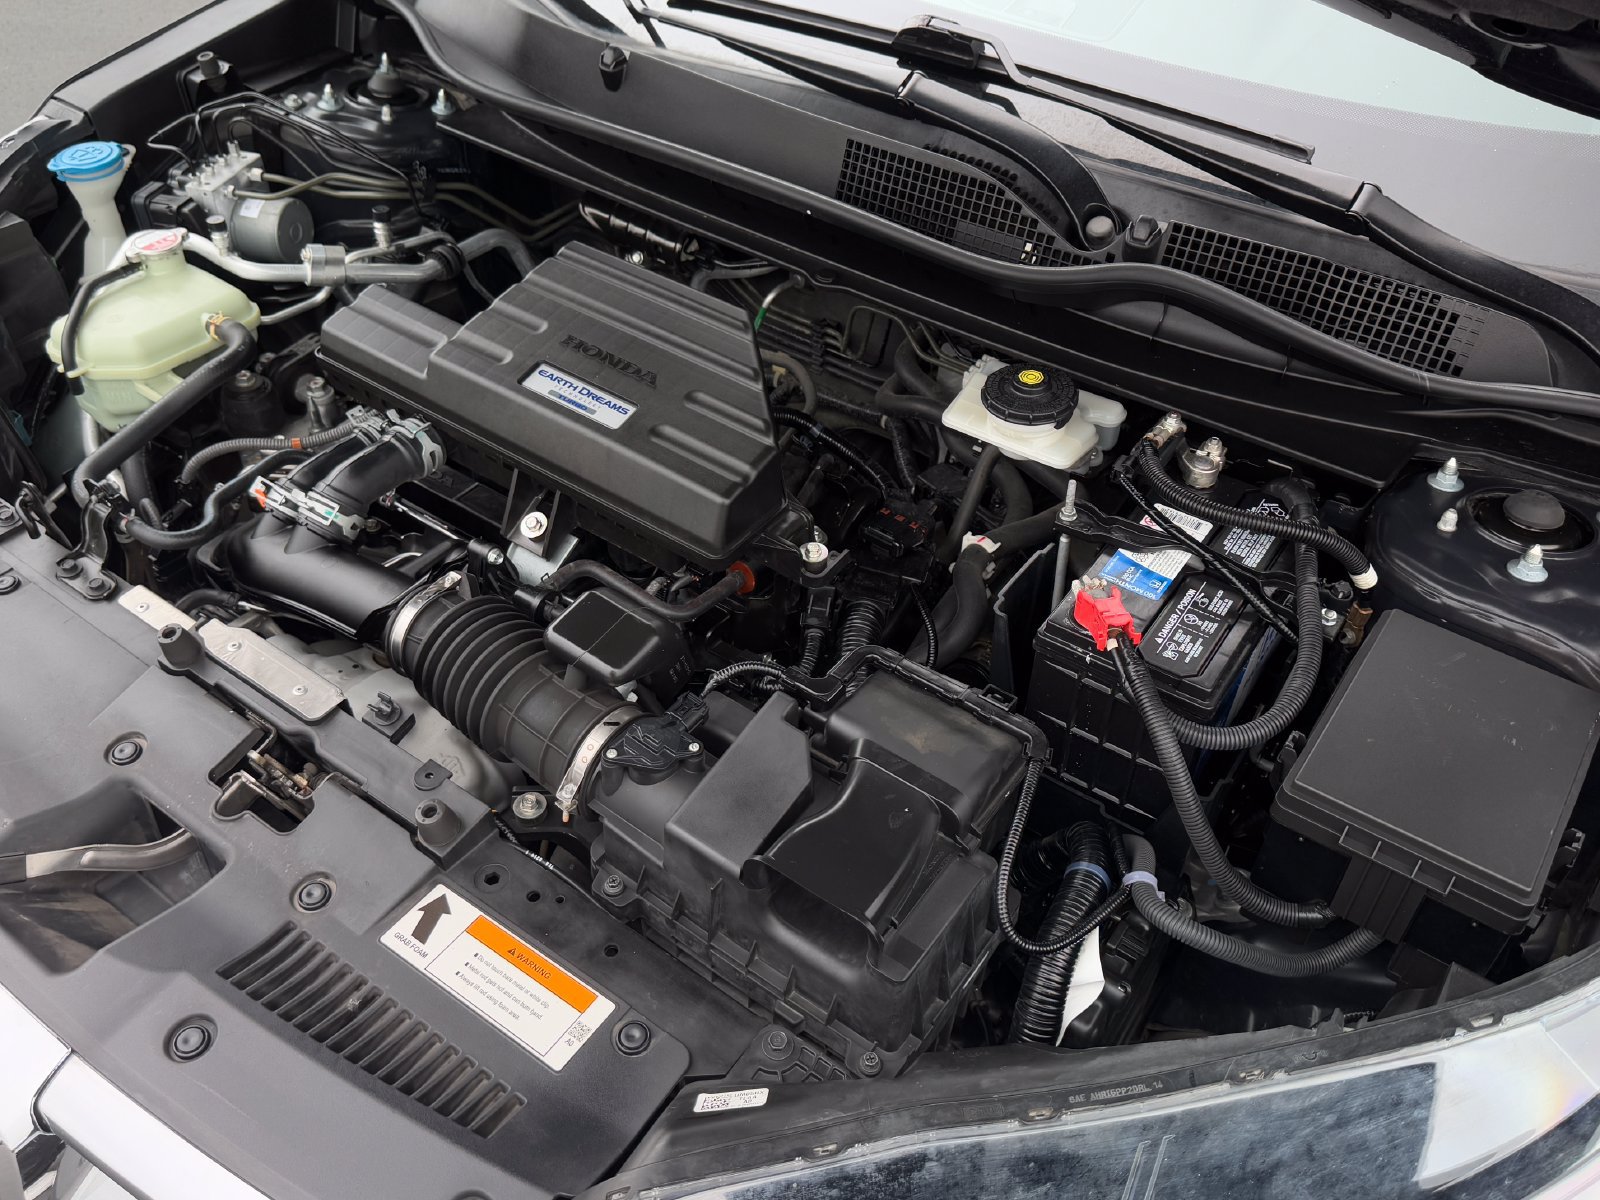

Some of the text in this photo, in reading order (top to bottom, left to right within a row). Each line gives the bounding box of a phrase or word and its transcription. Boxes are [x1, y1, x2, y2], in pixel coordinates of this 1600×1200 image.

[561, 335, 657, 388] HONDA
[538, 369, 630, 415] EARTH DREAMS
[558, 394, 588, 411] TURBO
[1161, 613, 1179, 638] DANGER
[1180, 588, 1197, 610] POISON
[394, 932, 429, 959] GRAB FOAM
[516, 953, 551, 980] WARNING
